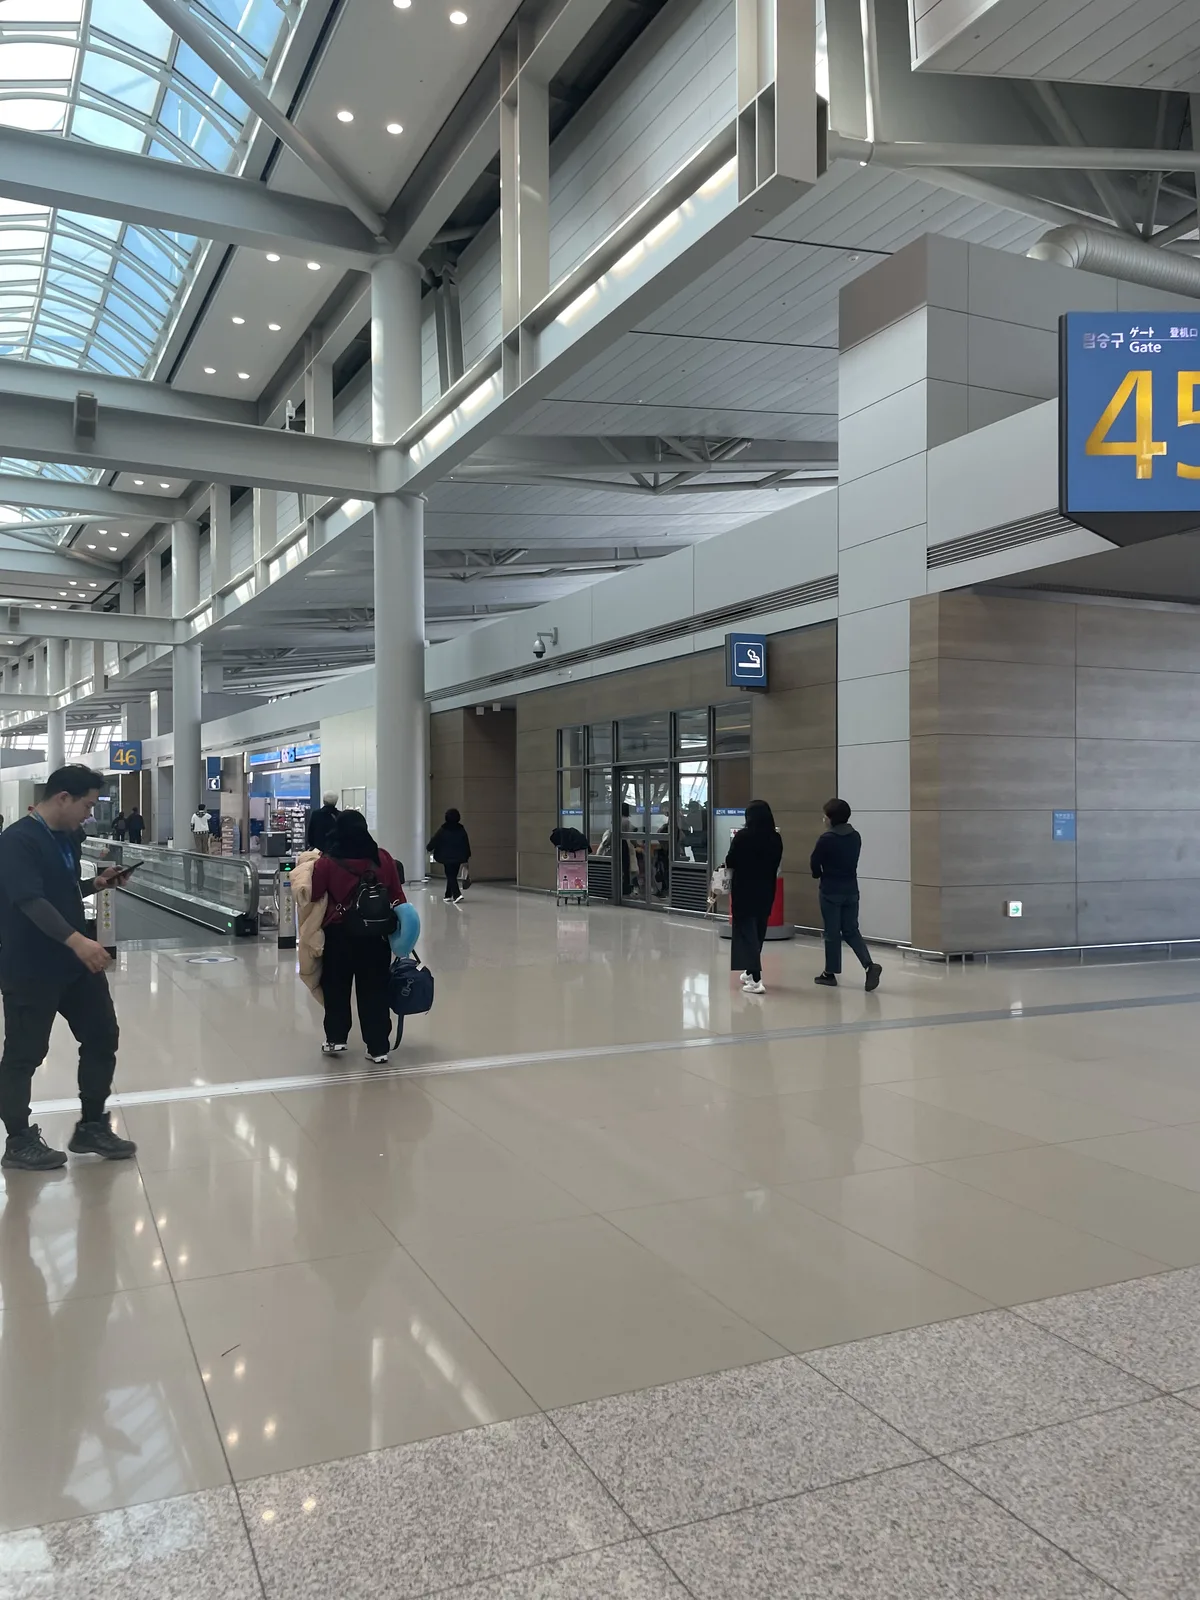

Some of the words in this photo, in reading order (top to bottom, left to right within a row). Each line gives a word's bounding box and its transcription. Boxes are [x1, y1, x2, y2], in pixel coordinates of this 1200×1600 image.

[1129, 326, 1155, 338] ゲート
[1169, 326, 1198, 338] 登机口
[1129, 341, 1162, 353] Gate
[112, 748, 137, 766] 46
